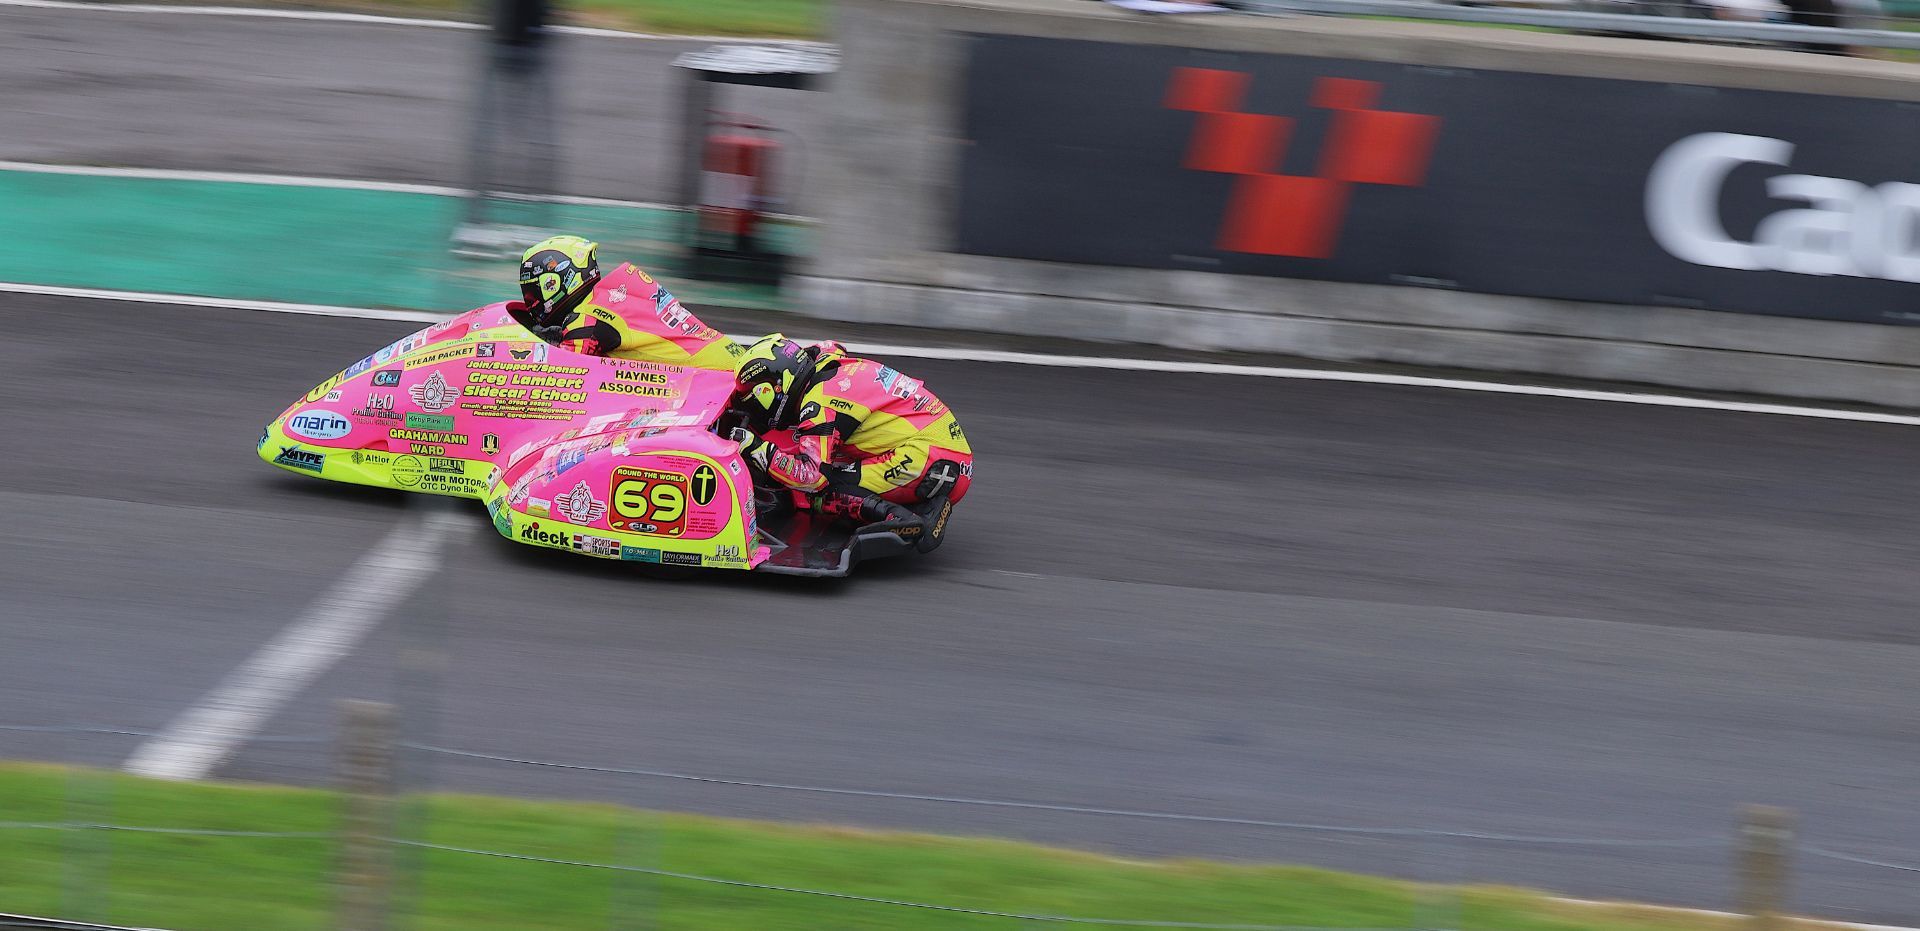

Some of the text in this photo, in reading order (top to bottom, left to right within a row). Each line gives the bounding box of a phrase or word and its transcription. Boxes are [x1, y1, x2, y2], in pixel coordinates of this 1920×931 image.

[593, 308, 616, 321] ARN
[406, 355, 436, 368] STEAM
[437, 347, 474, 360] PACKET
[466, 361, 589, 375] Join/Support/Sponsor
[629, 361, 684, 374] CHARLTON
[468, 372, 584, 389] Greg Lambert
[615, 369, 667, 384] HAYNES
[463, 385, 588, 403] Sidecar School
[598, 381, 681, 398] ASSOCIATES
[830, 399, 854, 411] ARN
[291, 415, 346, 431] marin
[389, 429, 468, 445] GRAHAM/ANN
[410, 443, 445, 456] WARD
[365, 454, 390, 464] Altior
[431, 458, 464, 471] MERLIN
[424, 474, 446, 483] GWR
[617, 468, 685, 482] ROUND THE WORLD
[420, 482, 478, 494] OTC Dyno Bike
[614, 479, 685, 522] 69
[521, 522, 570, 546] Rieck
[592, 537, 611, 548] SPORTS
[592, 546, 611, 556] TRAVEL
